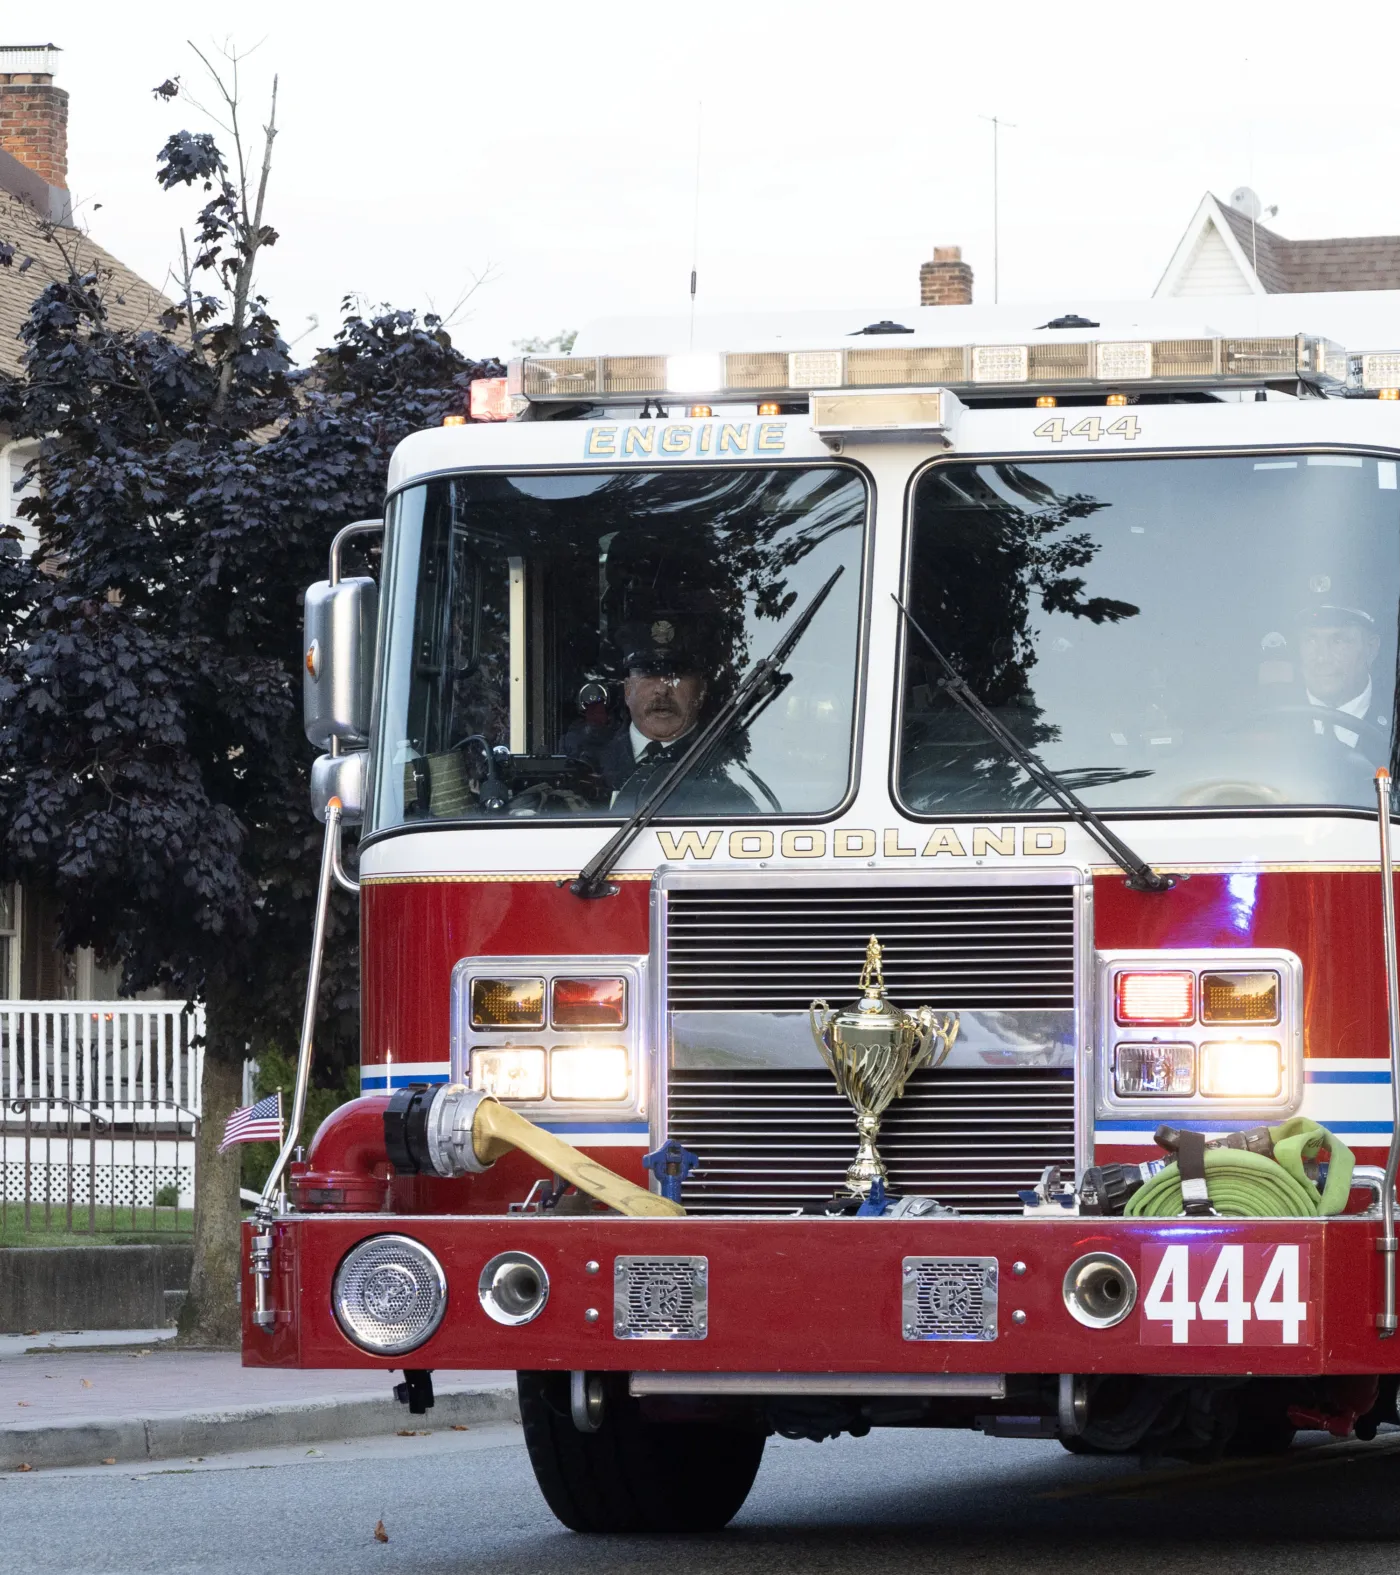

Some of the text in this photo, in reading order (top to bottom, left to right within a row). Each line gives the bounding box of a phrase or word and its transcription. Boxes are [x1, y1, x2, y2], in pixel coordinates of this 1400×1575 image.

[584, 423, 787, 458] ENGINE
[1033, 416, 1141, 442] 444
[656, 826, 1067, 861] WOODLAND
[1143, 1244, 1307, 1344] 444
